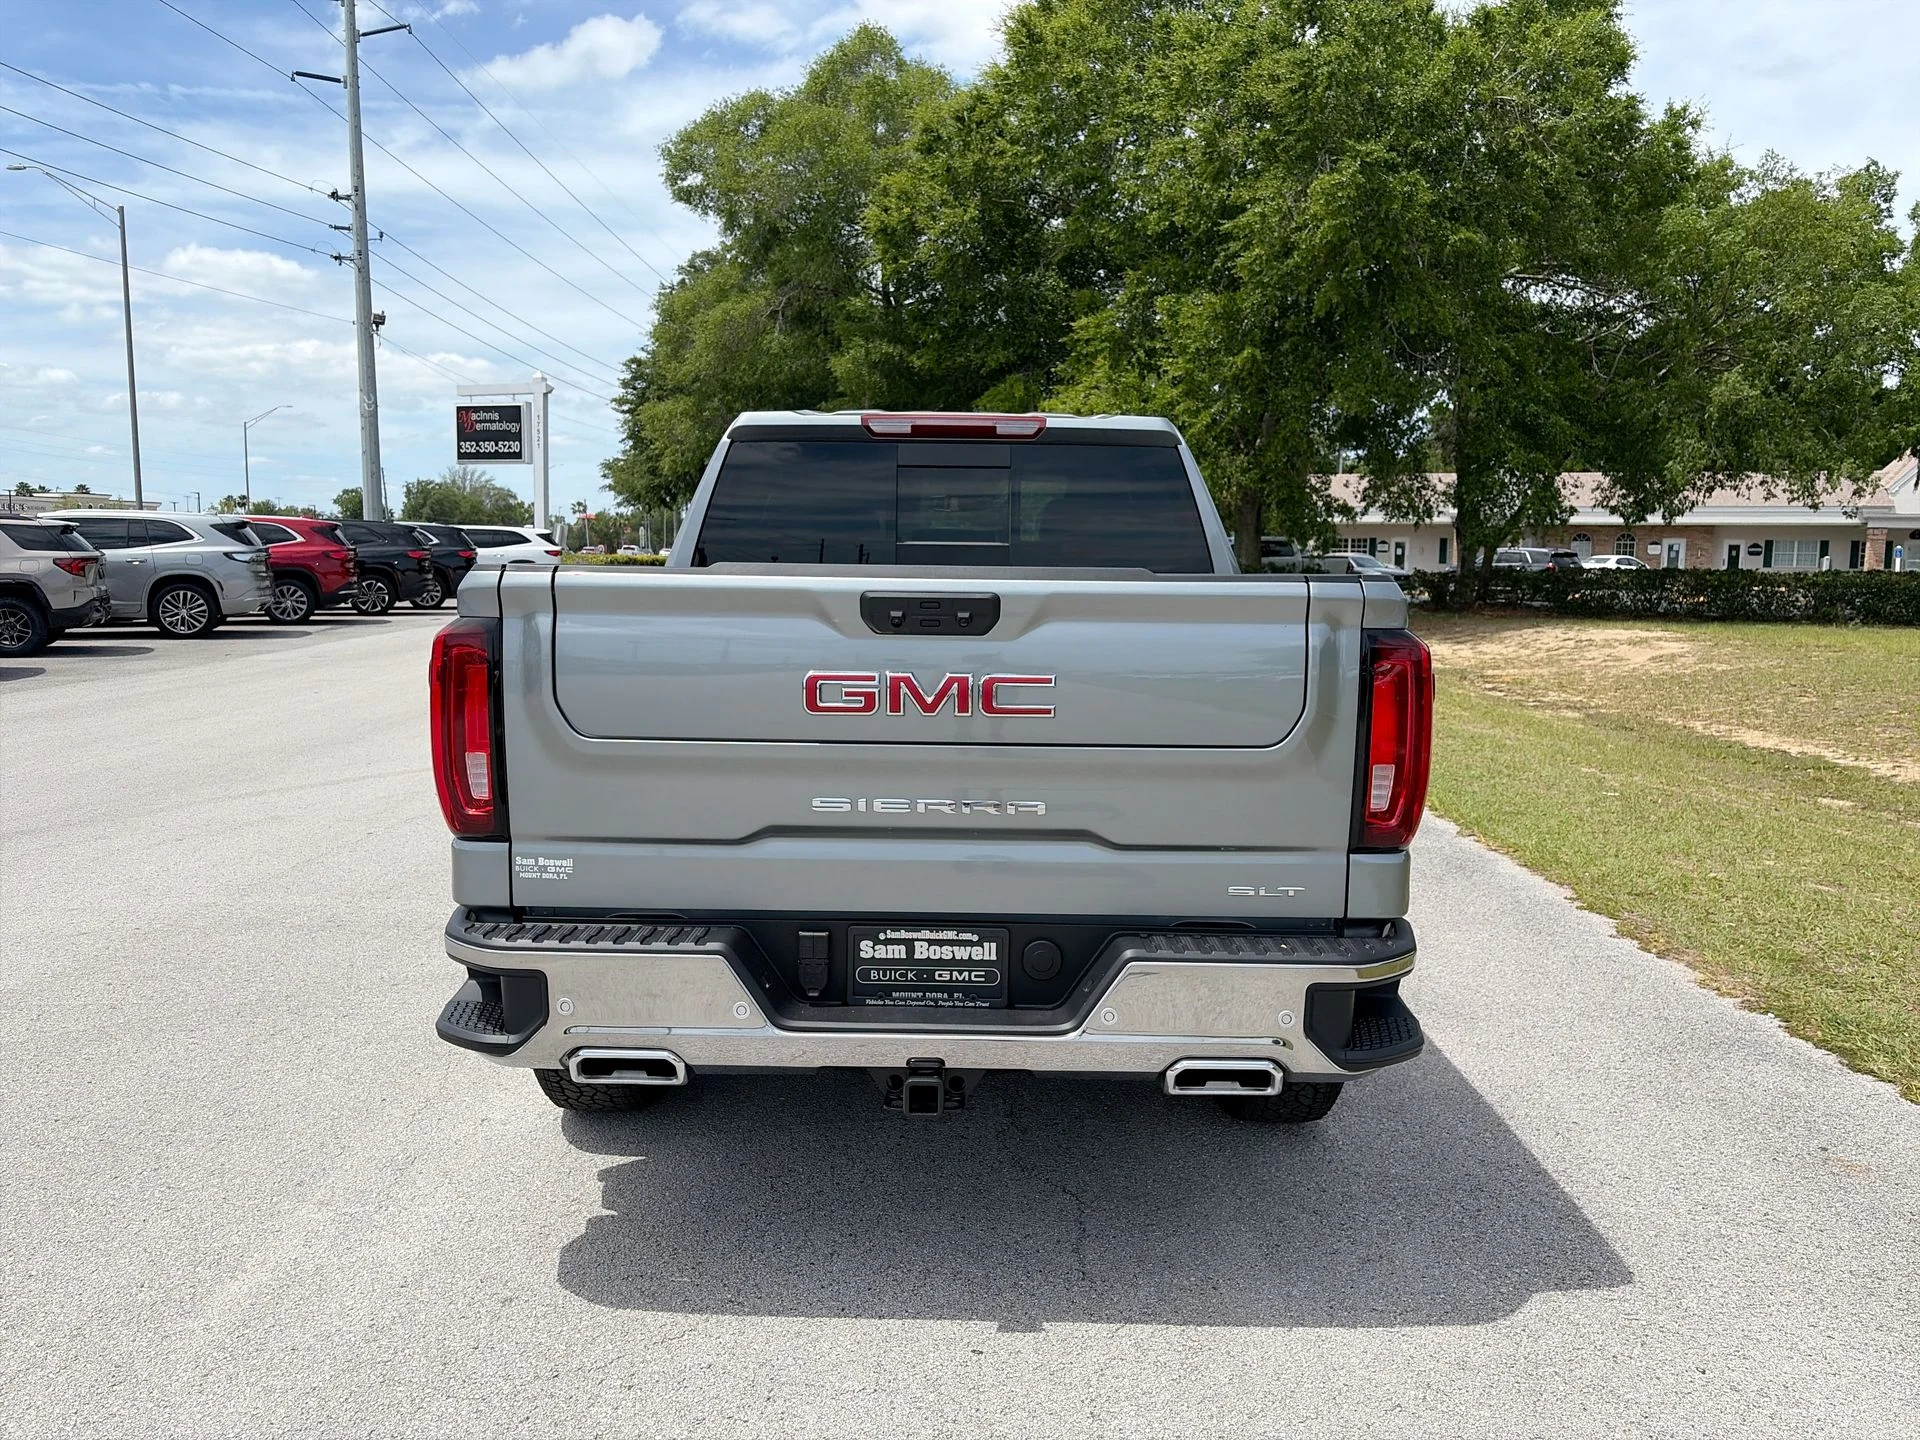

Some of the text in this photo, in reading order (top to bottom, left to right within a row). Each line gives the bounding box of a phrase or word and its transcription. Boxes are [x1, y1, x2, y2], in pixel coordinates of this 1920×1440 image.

[458, 409, 499, 423] MacInnis
[464, 420, 520, 433] Dermatology
[460, 441, 520, 453] 352-350-5230
[803, 670, 1056, 718] GMC
[811, 797, 1046, 816] SIERRA
[515, 856, 574, 867] Sam Boswell
[1227, 886, 1306, 897] SLT
[886, 929, 973, 941] SamBoswellBuickGMC.com
[859, 940, 998, 961] Sam Boswell
[870, 970, 986, 982] BUICK GMC
[906, 999, 926, 1007] Depend
